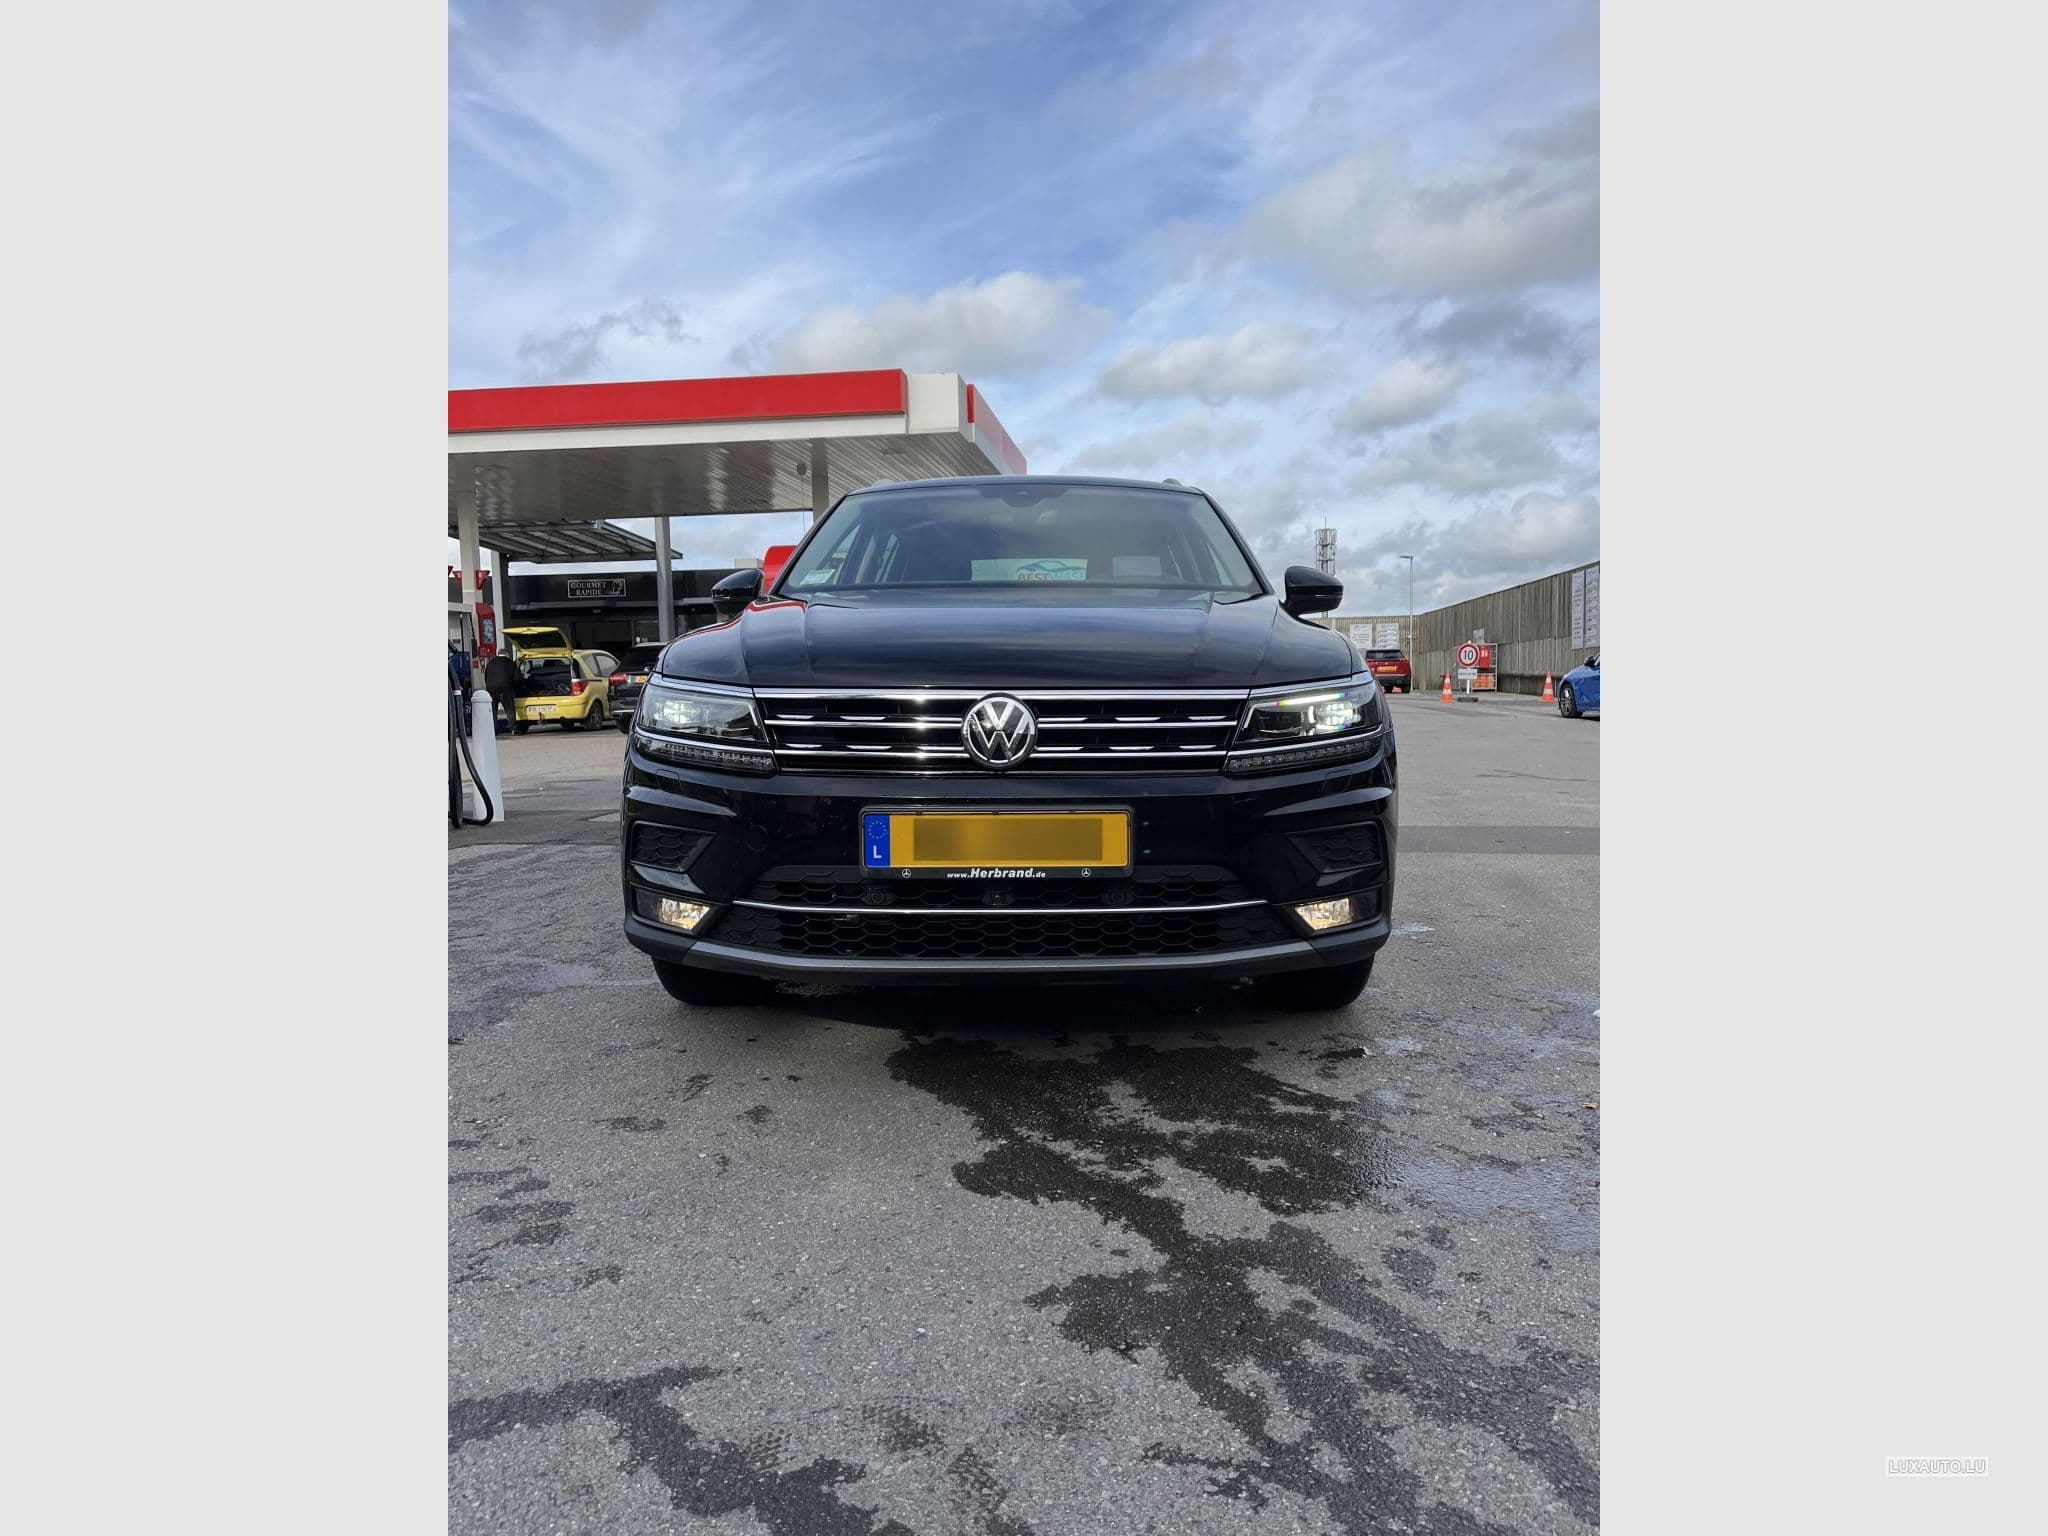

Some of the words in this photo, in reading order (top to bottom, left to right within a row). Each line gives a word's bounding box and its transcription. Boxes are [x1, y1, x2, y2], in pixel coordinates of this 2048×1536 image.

[570, 581, 606, 589] GOURMET
[1463, 650, 1473, 660] 10
[873, 845, 882, 859] L
[946, 867, 1046, 878] www.Herbrand.de
